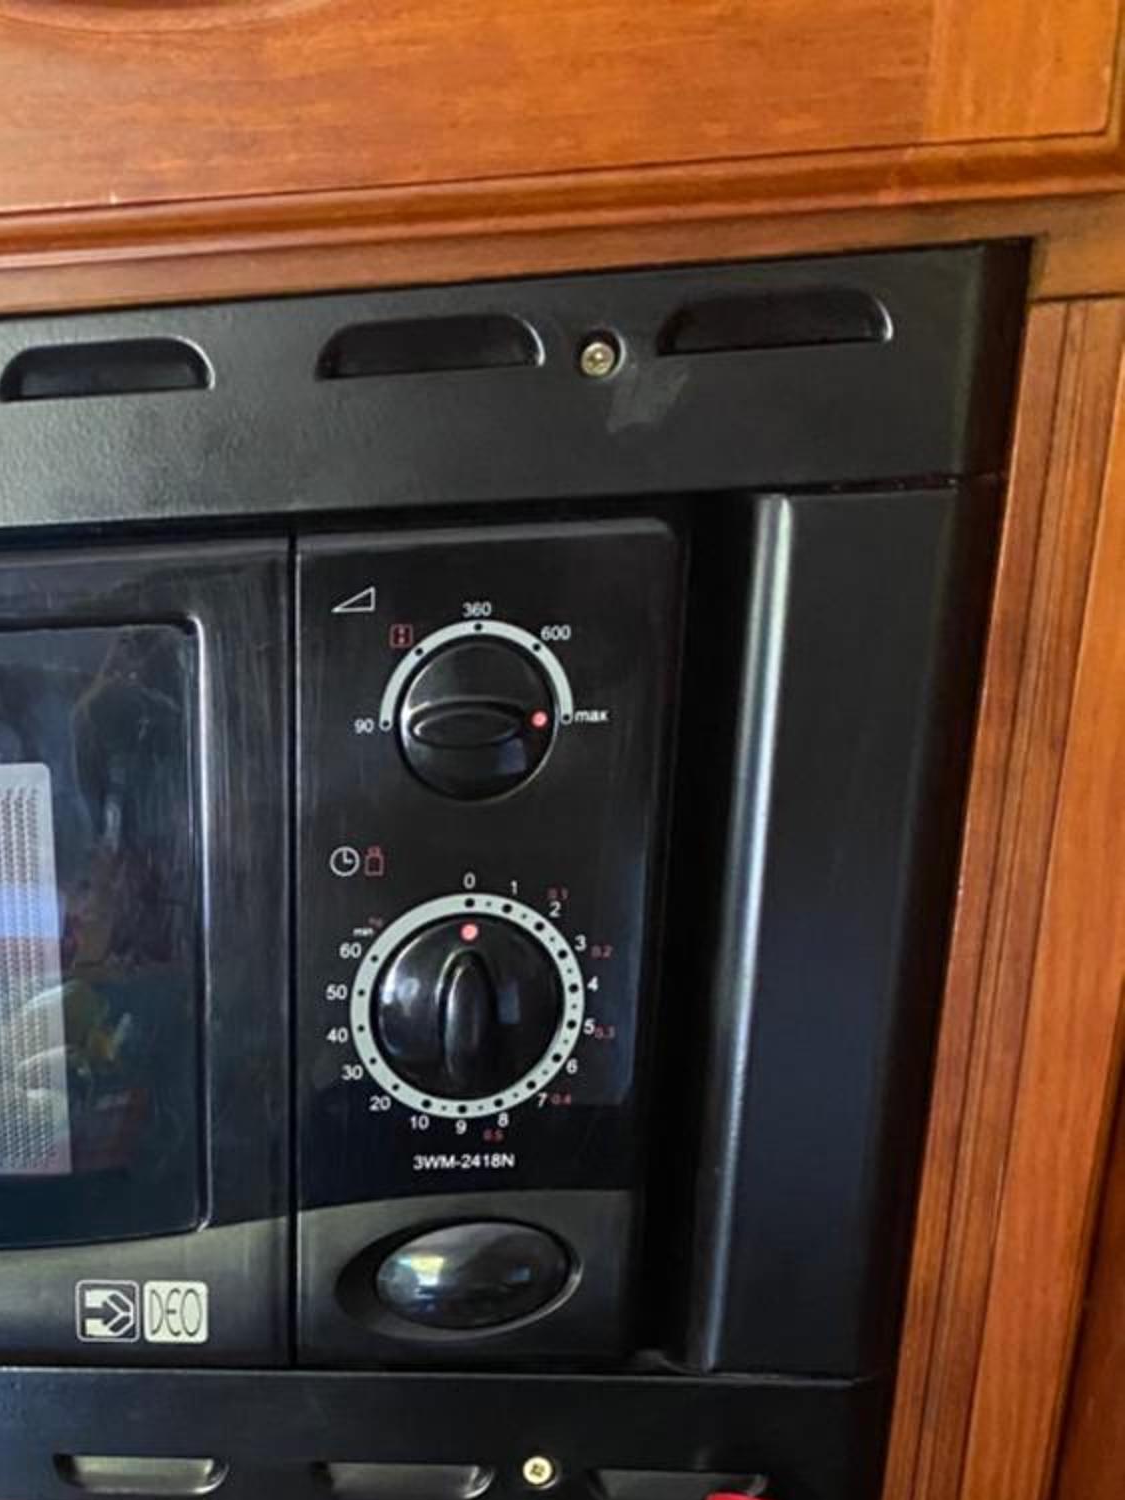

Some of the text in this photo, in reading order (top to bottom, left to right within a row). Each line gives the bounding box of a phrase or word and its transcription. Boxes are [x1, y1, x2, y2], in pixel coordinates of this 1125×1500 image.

[462, 602, 492, 616] 360
[541, 625, 571, 641] 600
[575, 711, 608, 722] max
[354, 719, 374, 733] 90
[464, 873, 475, 889] 0
[511, 881, 518, 894] 1
[549, 903, 560, 916] 2
[575, 935, 587, 949] 3
[340, 943, 361, 958] 60
[588, 977, 598, 991] 4
[326, 985, 347, 1000] 50
[584, 1020, 595, 1034] 5
[326, 1027, 348, 1043] 40
[342, 1065, 363, 1079] 30
[567, 1059, 578, 1074] 6
[369, 1096, 390, 1111] 20
[539, 1093, 547, 1107] 7
[411, 1115, 429, 1130] 10
[456, 1119, 466, 1134] 9
[498, 1113, 508, 1127] 8
[413, 1153, 514, 1171] 3WM-2418N
[150, 1288, 202, 1337] DEO
